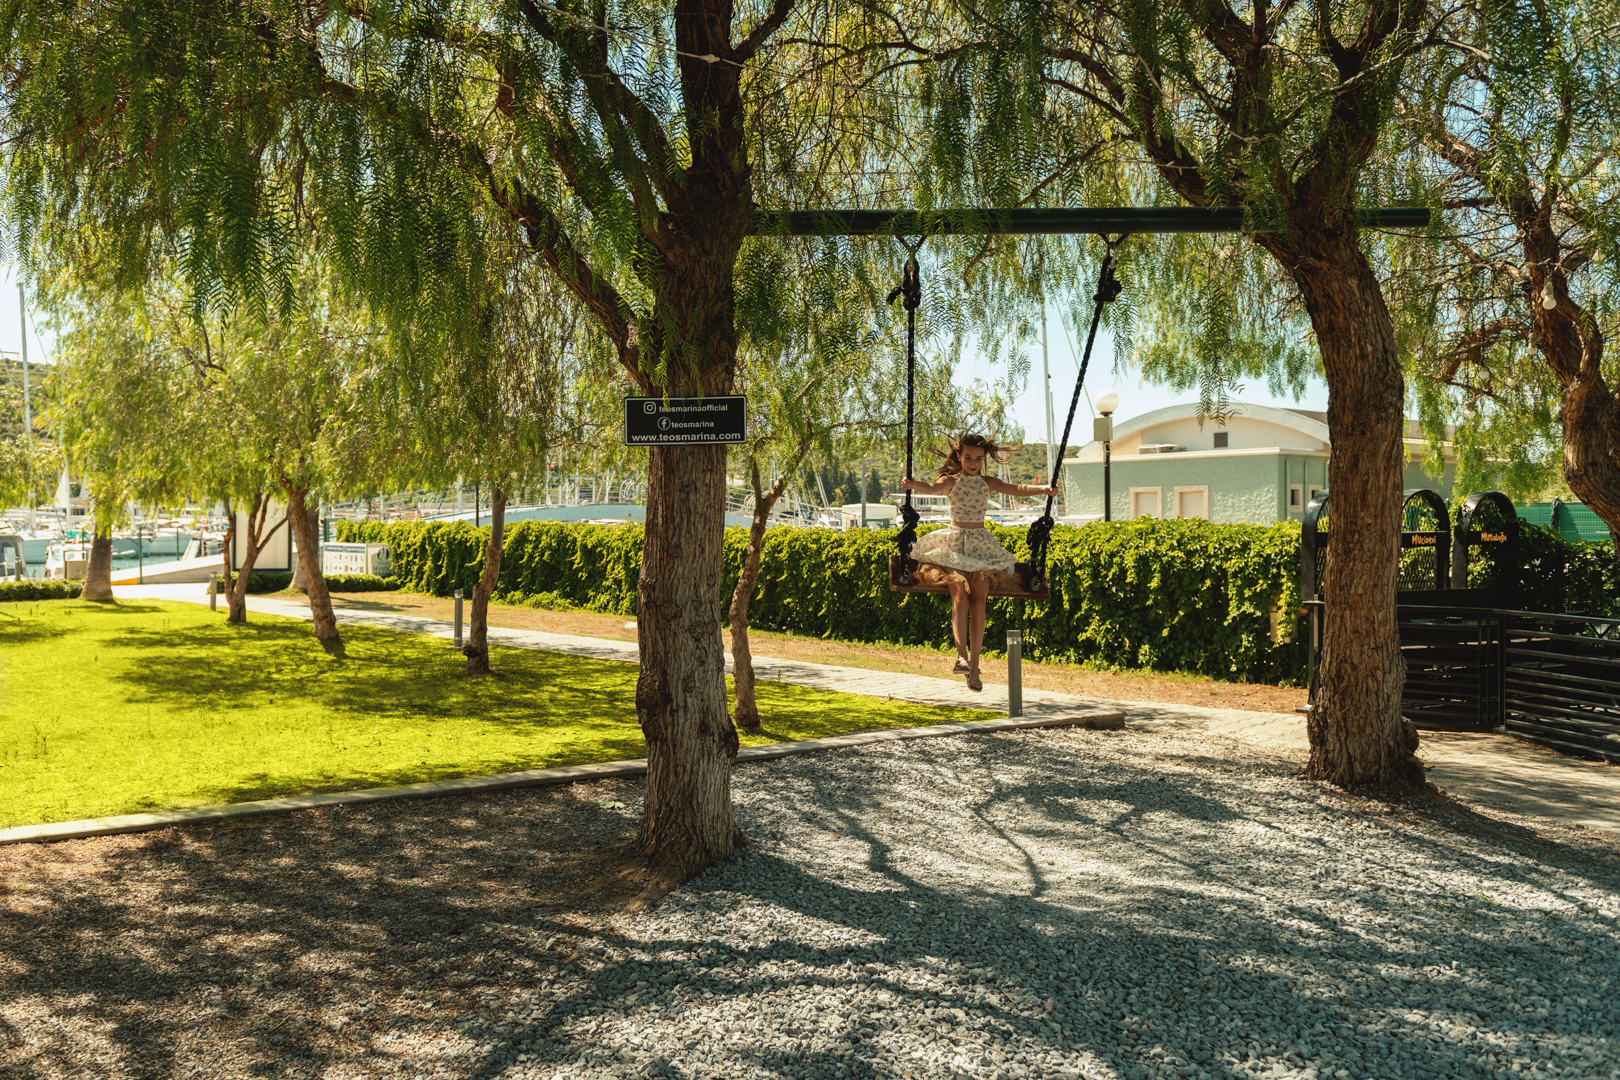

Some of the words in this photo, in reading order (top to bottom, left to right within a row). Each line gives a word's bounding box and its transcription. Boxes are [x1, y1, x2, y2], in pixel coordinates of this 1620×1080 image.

[659, 404, 728, 412] teosmarinaofficial
[672, 420, 714, 428] teosmarina
[632, 432, 740, 441] www.teosmarina.com
